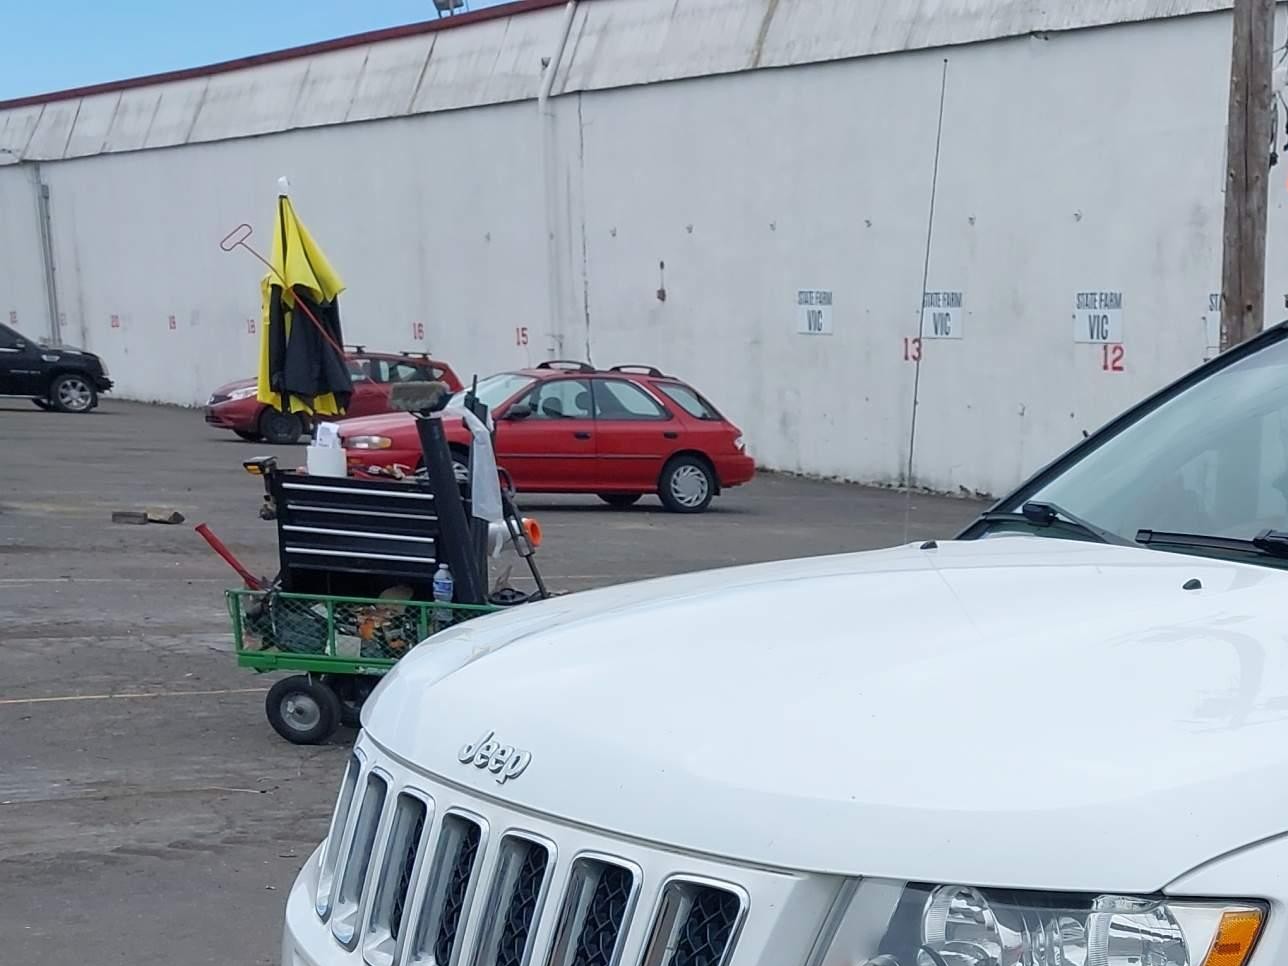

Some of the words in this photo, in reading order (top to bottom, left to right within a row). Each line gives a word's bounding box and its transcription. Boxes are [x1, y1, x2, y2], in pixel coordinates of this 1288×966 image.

[1076, 292, 1098, 309] STATE
[1099, 292, 1122, 309] FARM
[807, 309, 823, 331] VIC
[933, 312, 951, 336] VIC
[1088, 314, 1109, 340] VIC
[516, 327, 529, 346] 15
[904, 337, 922, 361] 13
[1103, 344, 1125, 371] 12
[458, 729, 532, 785] Jeep
